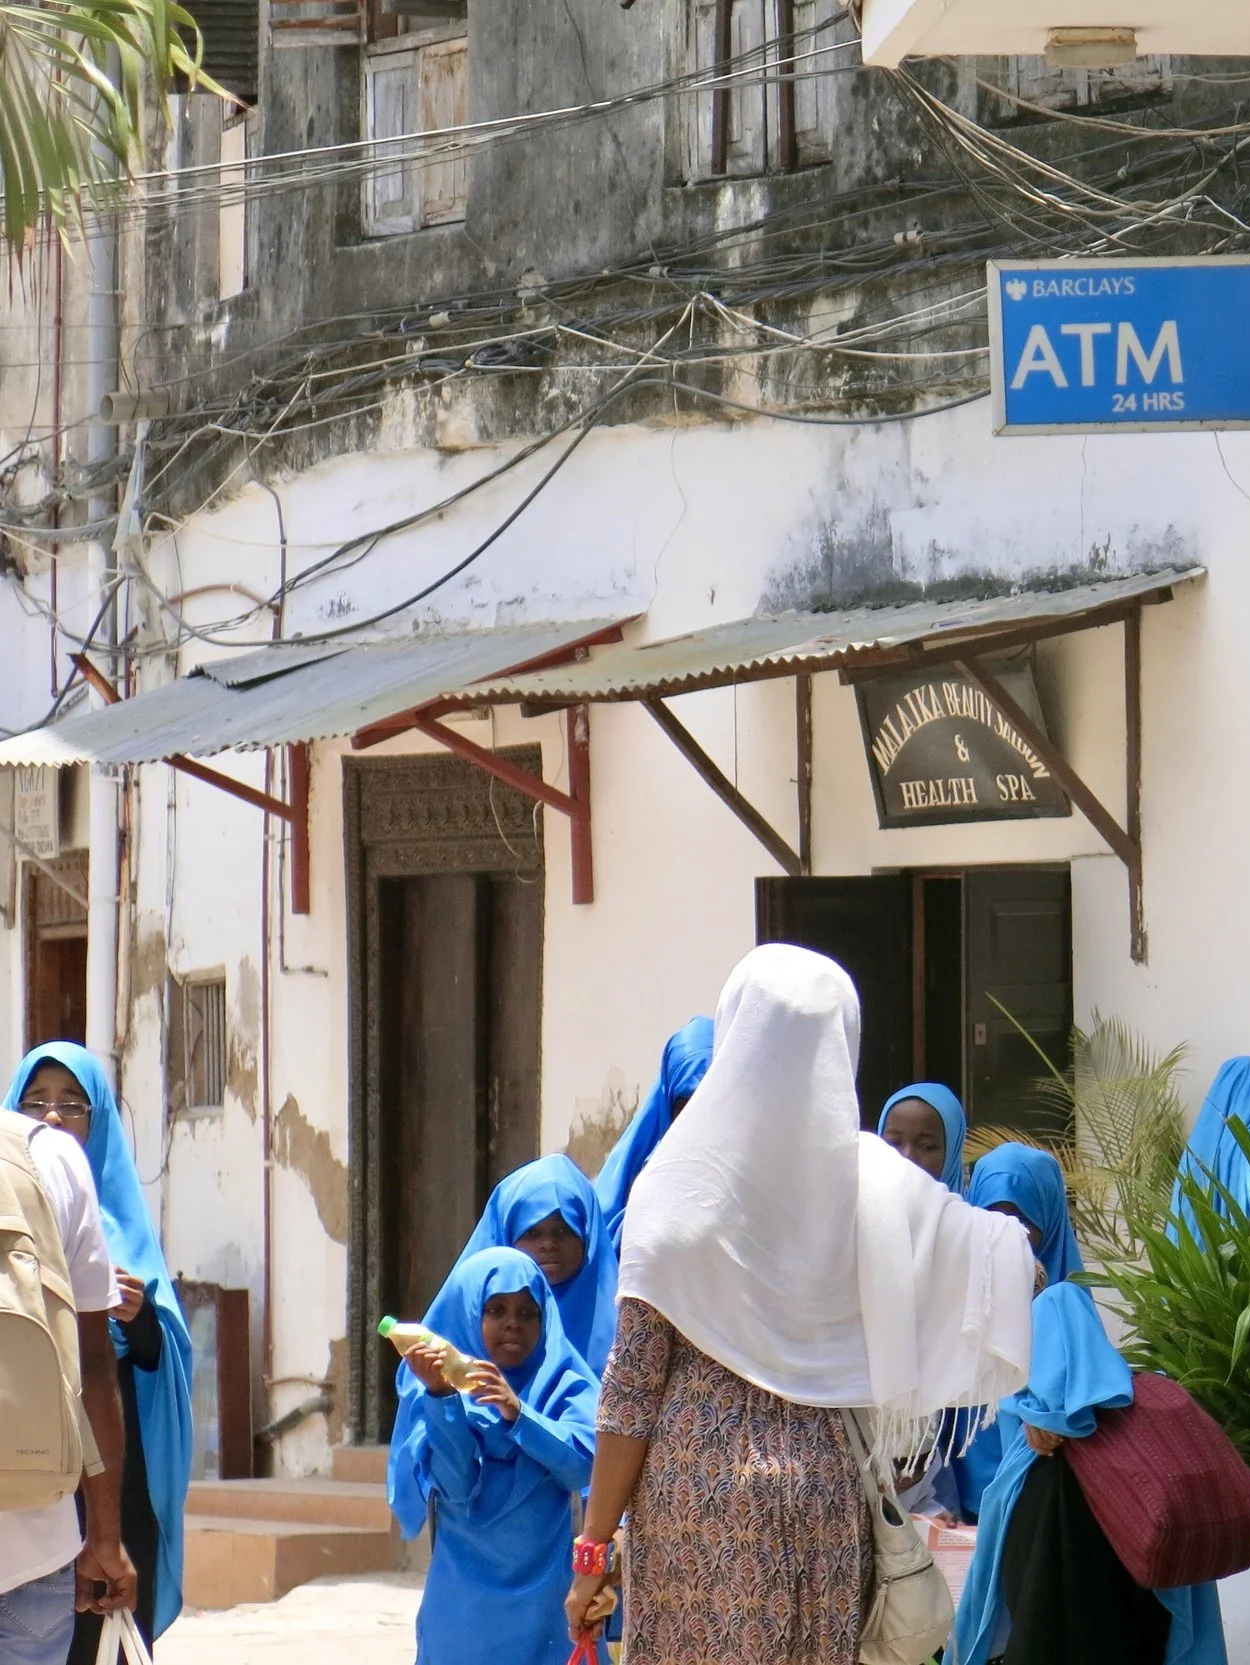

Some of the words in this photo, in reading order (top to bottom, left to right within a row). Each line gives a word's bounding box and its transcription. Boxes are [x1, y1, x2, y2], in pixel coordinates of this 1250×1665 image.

[1032, 277, 1136, 297] BARCLAYS
[1010, 320, 1184, 389] ATM
[1112, 394, 1138, 412] 24
[1143, 392, 1185, 411] HRS
[872, 684, 946, 776] MALAIKA
[942, 682, 992, 727] BEAUTY
[954, 734, 970, 763] &
[900, 777, 979, 809] HEALTH
[996, 774, 1037, 801] SPA
